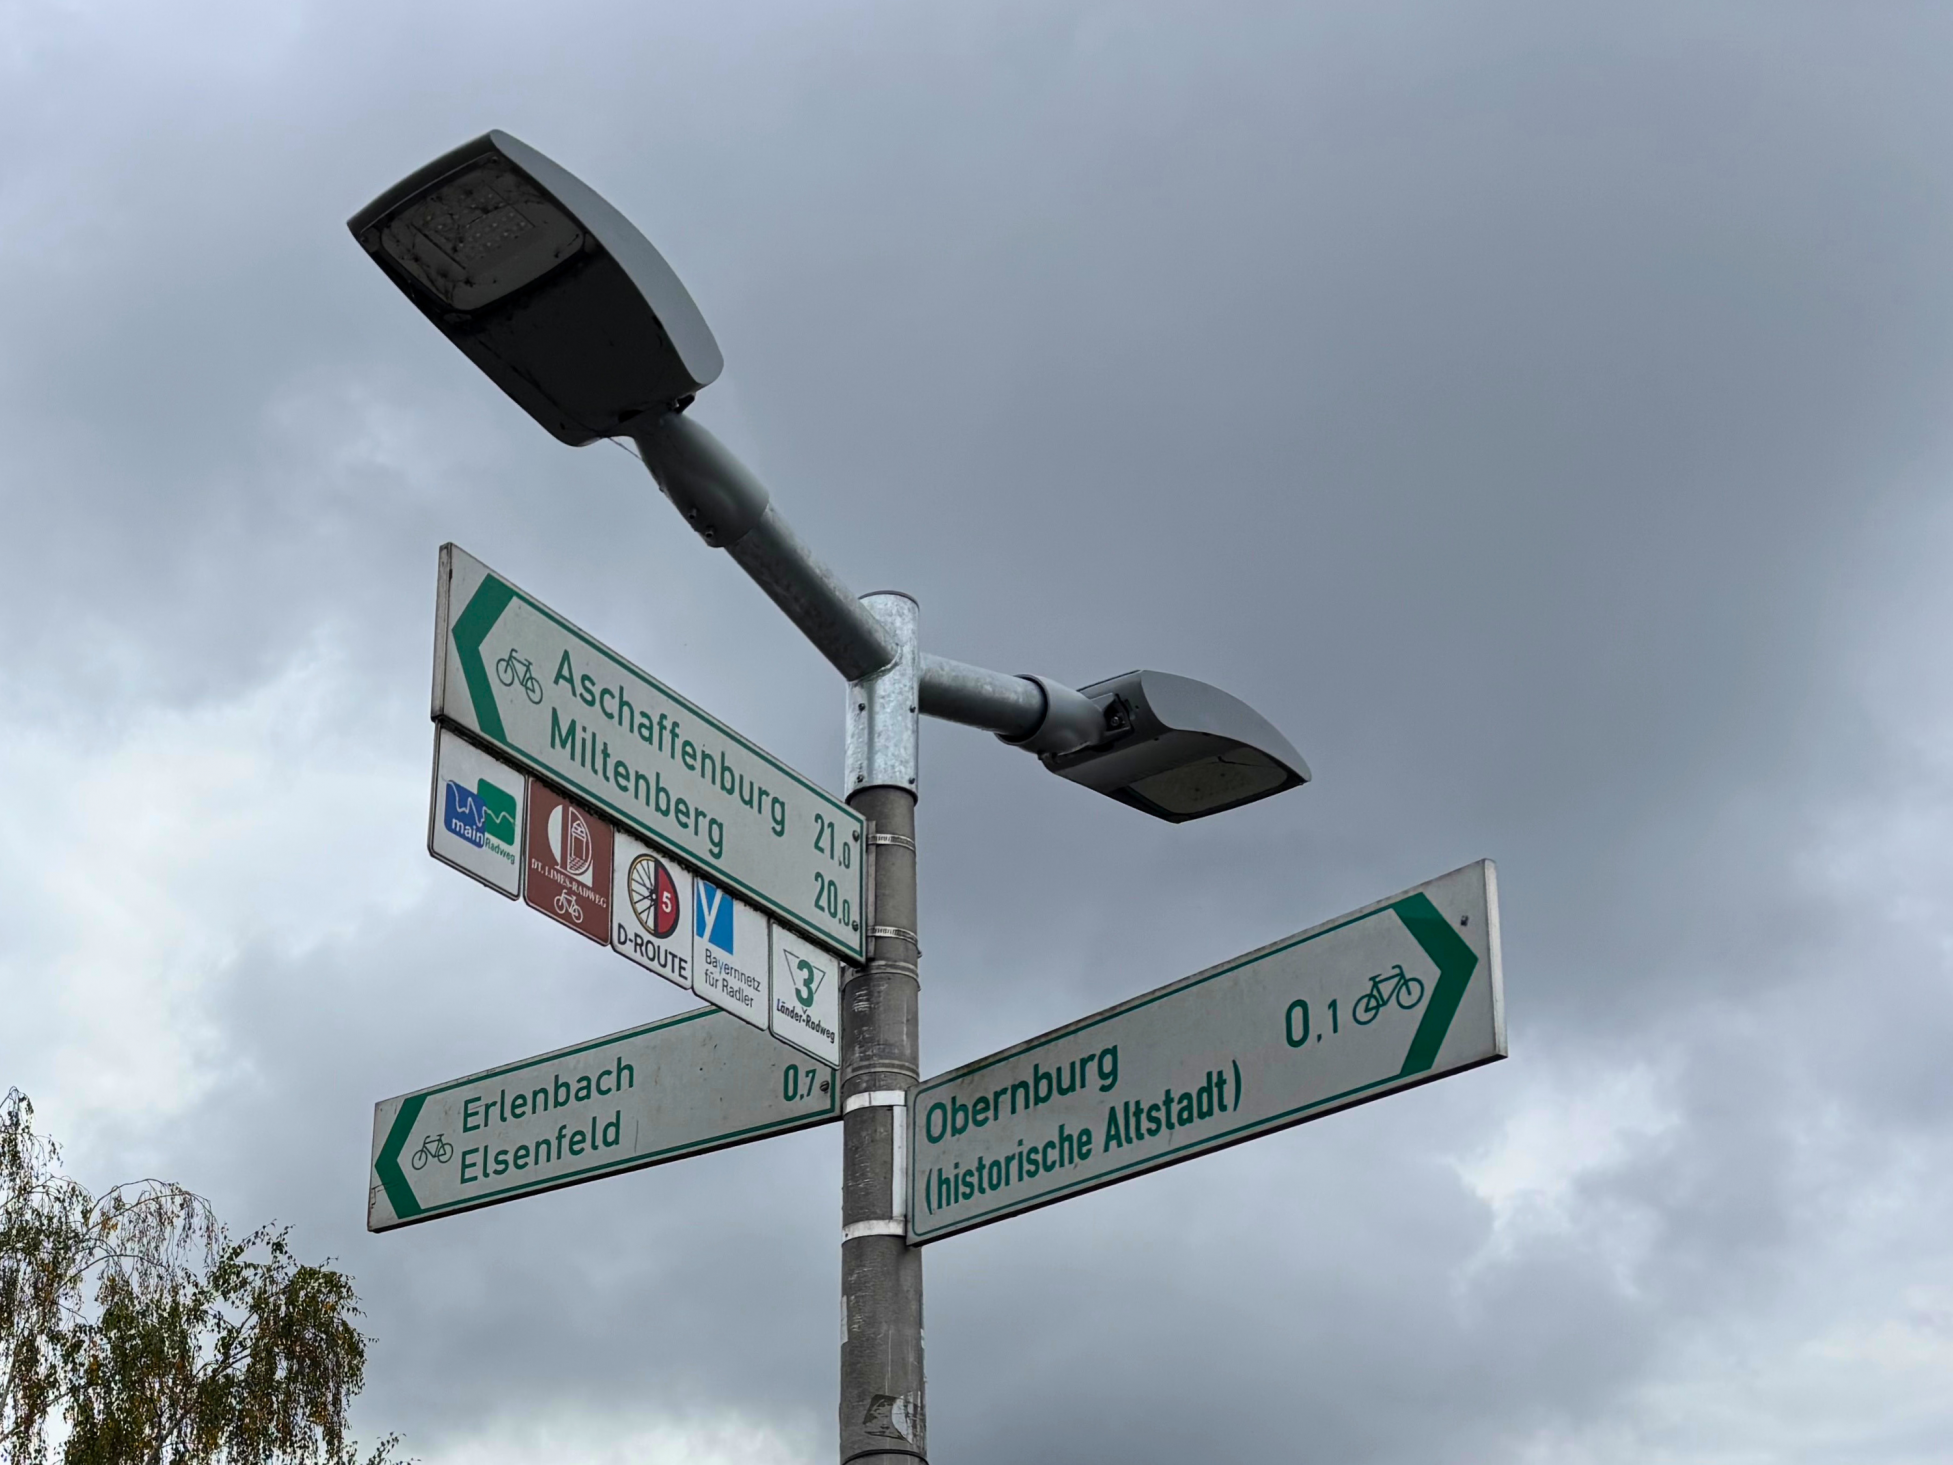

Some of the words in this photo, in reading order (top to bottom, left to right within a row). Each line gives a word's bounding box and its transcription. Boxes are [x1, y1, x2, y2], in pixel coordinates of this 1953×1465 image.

[553, 649, 786, 837] Aschaffenburg
[550, 707, 724, 860] Miltenberg
[451, 817, 484, 846] main
[485, 838, 516, 865] Radweg
[661, 891, 672, 913] 5
[617, 922, 689, 981] D-ROUTE
[704, 948, 762, 993] Bayernnetz
[704, 970, 719, 988] für
[722, 983, 755, 1008] Radler
[795, 959, 815, 1008] 3
[776, 999, 836, 1044] Länder-Radweg
[462, 1056, 635, 1134] Erlenbach
[925, 1043, 1120, 1144] Obernburg
[460, 1110, 621, 1185] Elsenfeld
[925, 1123, 1093, 1216] (historische
[1103, 1059, 1243, 1153] Altstadt)
